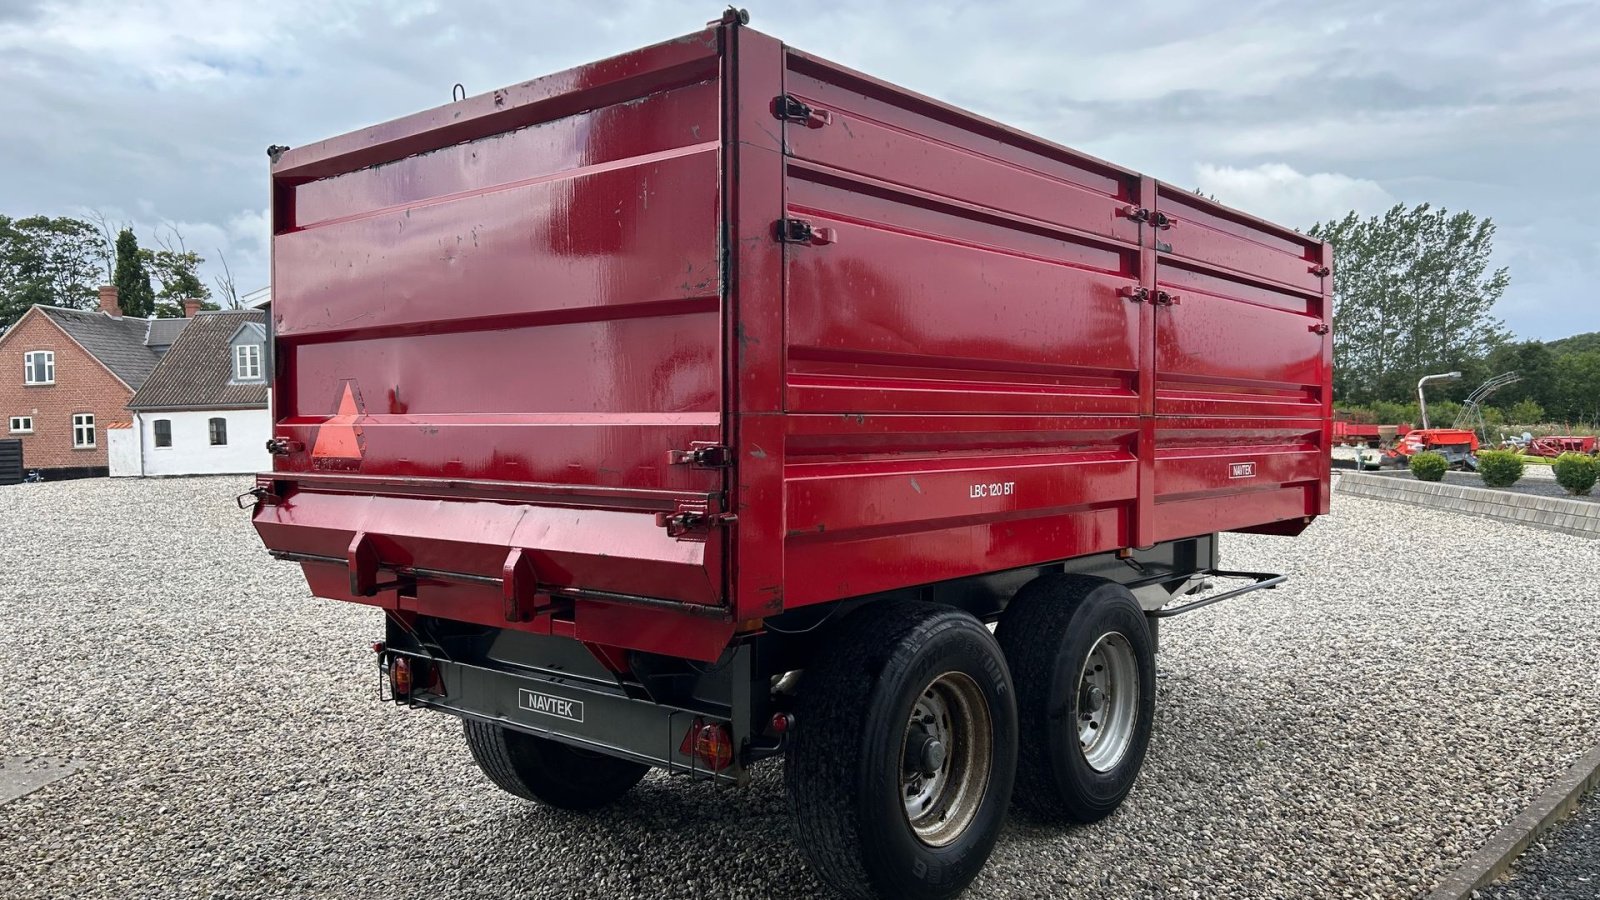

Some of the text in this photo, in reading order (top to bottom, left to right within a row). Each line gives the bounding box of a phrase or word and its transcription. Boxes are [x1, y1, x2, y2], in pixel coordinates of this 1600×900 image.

[1232, 464, 1252, 476] NAVTEK
[970, 481, 1015, 498] LBC 120 BT
[528, 693, 573, 717] NAVTEK
